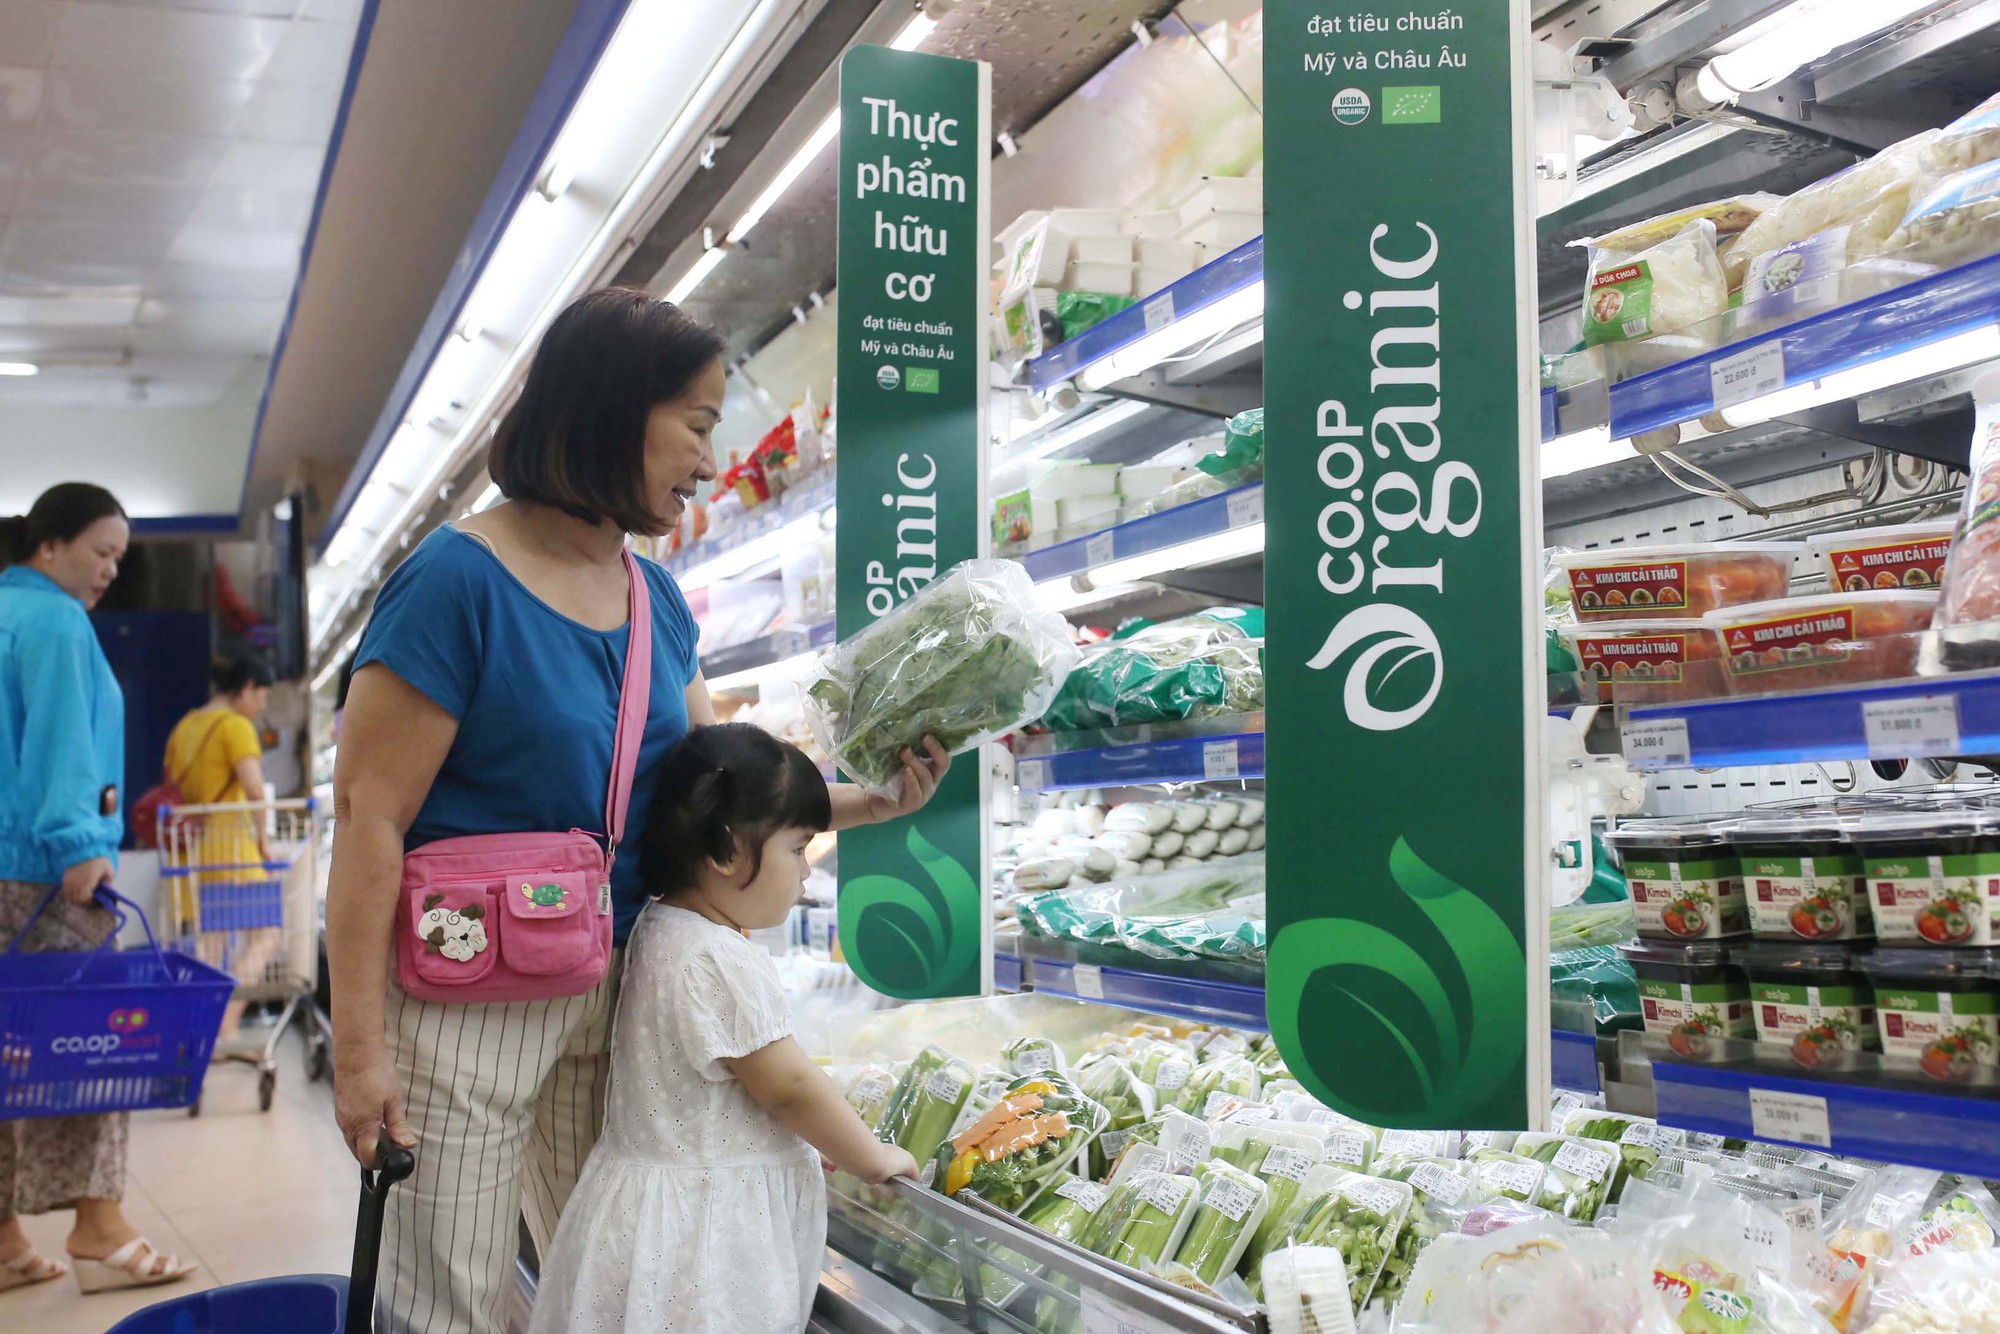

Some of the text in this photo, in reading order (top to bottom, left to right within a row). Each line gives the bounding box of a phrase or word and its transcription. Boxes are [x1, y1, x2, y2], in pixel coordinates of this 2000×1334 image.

[1307, 9, 1464, 37] đạt tiêu chuẩn
[1304, 45, 1467, 76] Mỹ và Châu Âu
[1339, 96, 1362, 105] USDA
[1336, 107, 1366, 116] ORGANIC
[862, 97, 958, 151] Thực
[857, 155, 966, 202] phẩm
[874, 211, 948, 256] hữu
[885, 272, 936, 302] cơ
[863, 315, 884, 331] đạt
[887, 317, 911, 332] tiêu
[861, 339, 954, 360] Mỹ và Châu Âu
[1316, 400, 1365, 595] CO.OP
[1862, 554, 1883, 567] KIM
[1884, 551, 1906, 564] CHI
[1927, 541, 1949, 559] THẢ
[1595, 573, 1614, 584] KIM
[1615, 571, 1631, 582] CHI
[1651, 565, 1678, 580] THẢO
[1753, 630, 1775, 641] KIM
[1775, 627, 1793, 639] CHI
[1814, 615, 1846, 632] THẢO
[1602, 643, 1619, 655] KIM
[1620, 644, 1635, 655] CHI
[1654, 639, 1678, 653] THẢO
[1647, 887, 1671, 898] Kimchi
[1773, 885, 1800, 897] Kimchi
[1657, 1006, 1682, 1019] Kimchi
[1779, 1012, 1807, 1025] Kimchi
